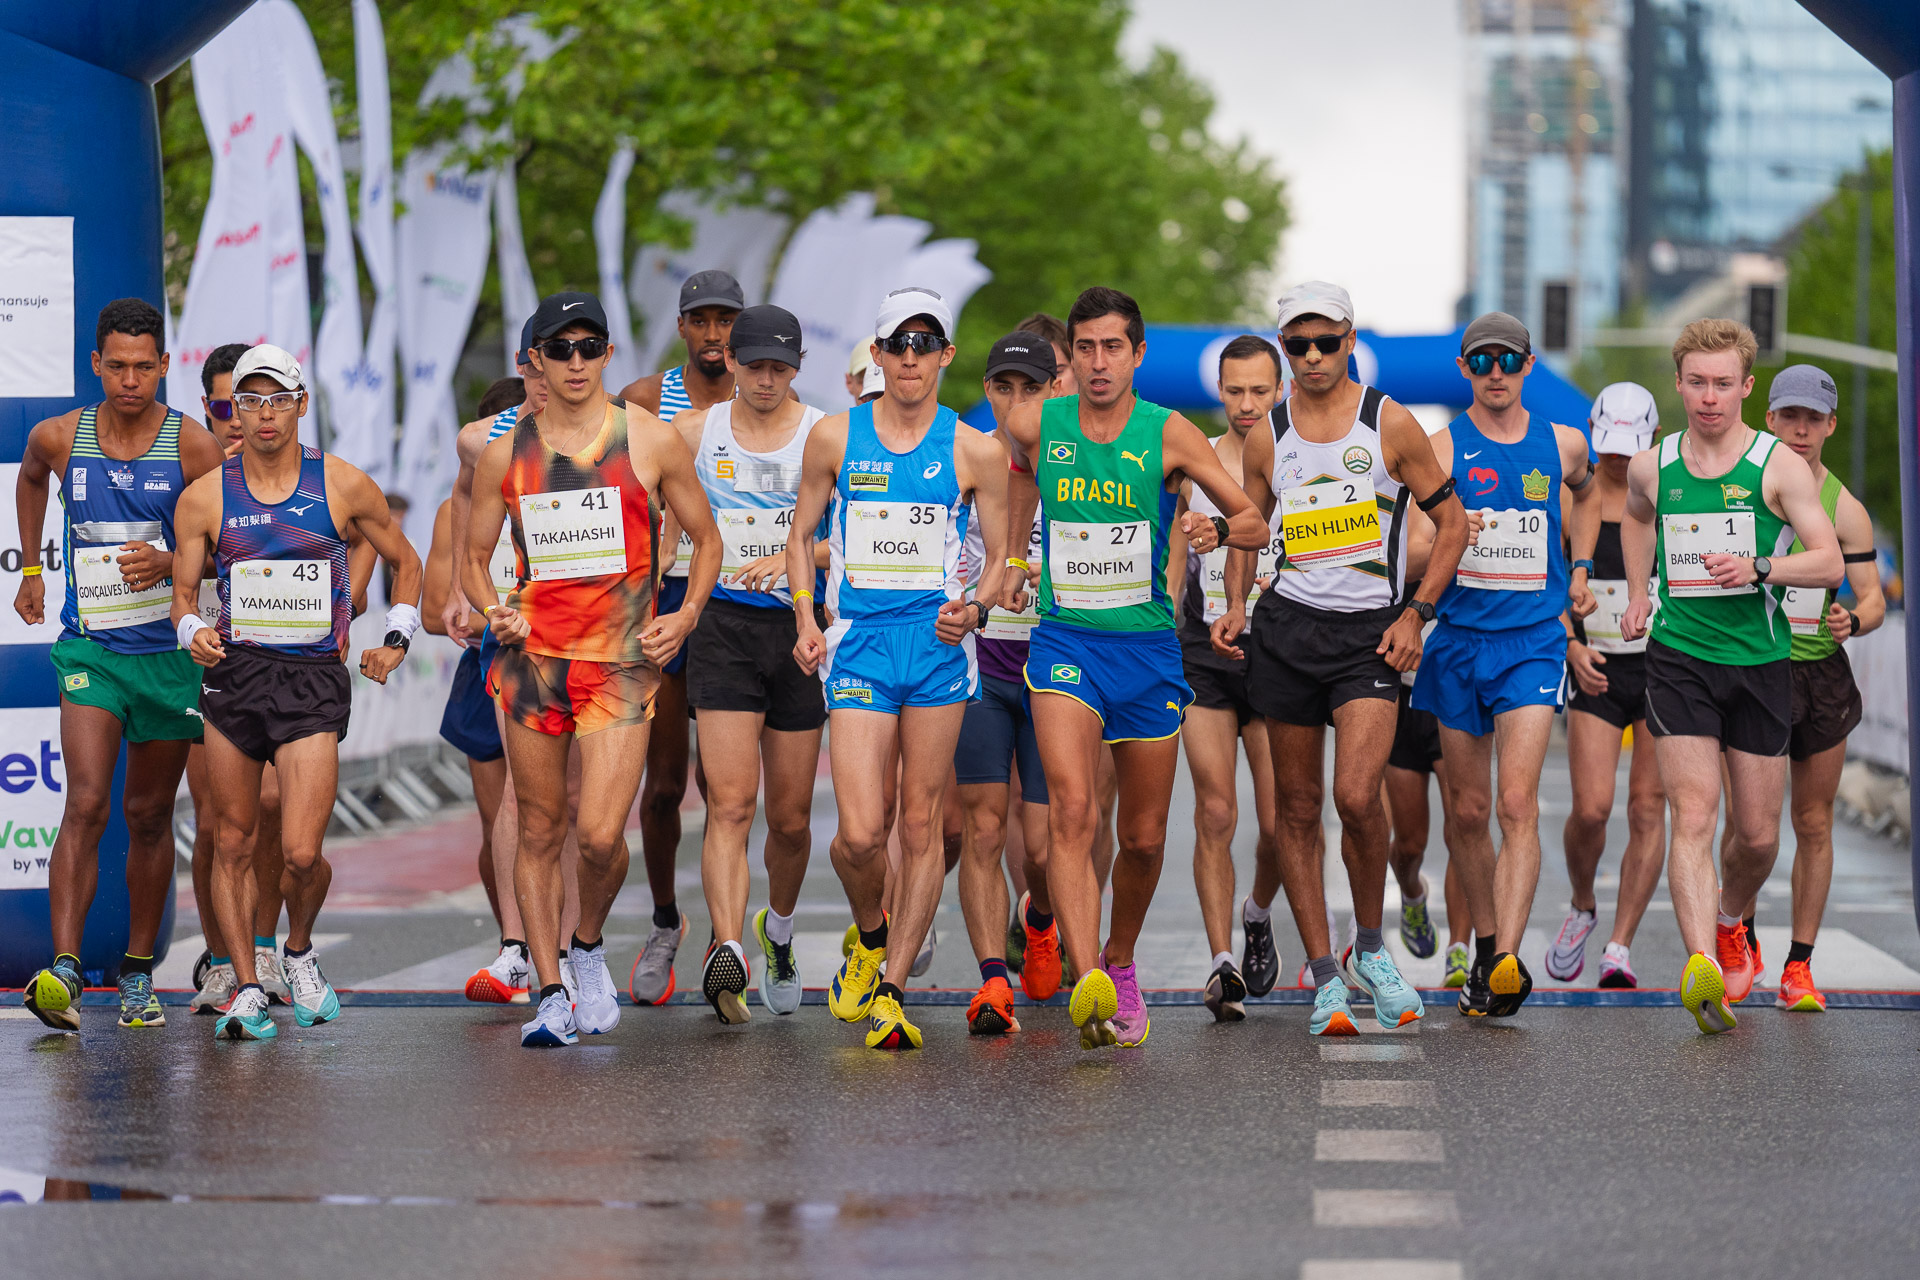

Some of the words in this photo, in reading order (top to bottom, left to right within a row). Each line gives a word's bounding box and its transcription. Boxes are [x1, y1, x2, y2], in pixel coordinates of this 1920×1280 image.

[1004, 346, 1030, 354] KIPRUN
[1347, 450, 1368, 462] RKS
[846, 460, 894, 474] 大塚製薬
[580, 491, 609, 511] 41
[1057, 477, 1137, 509] BRASIL
[1343, 485, 1357, 503] 2
[228, 513, 272, 529] 愛知製鋼
[909, 505, 936, 525] 35
[1285, 523, 1317, 542] BEN
[1323, 513, 1378, 535] HLIMA
[1518, 516, 1540, 534] 10
[1725, 517, 1737, 536] 1
[531, 526, 615, 546] TAKAHASHI
[1110, 525, 1138, 545] 27
[872, 540, 919, 555] KOGA
[1472, 546, 1536, 559] SCHIEDEL
[292, 563, 319, 582] 43
[1067, 560, 1134, 576] BONFIM
[78, 583, 123, 600] GONÇALVES
[239, 596, 322, 611] YAMANISHI
[13, 858, 31, 874] by
